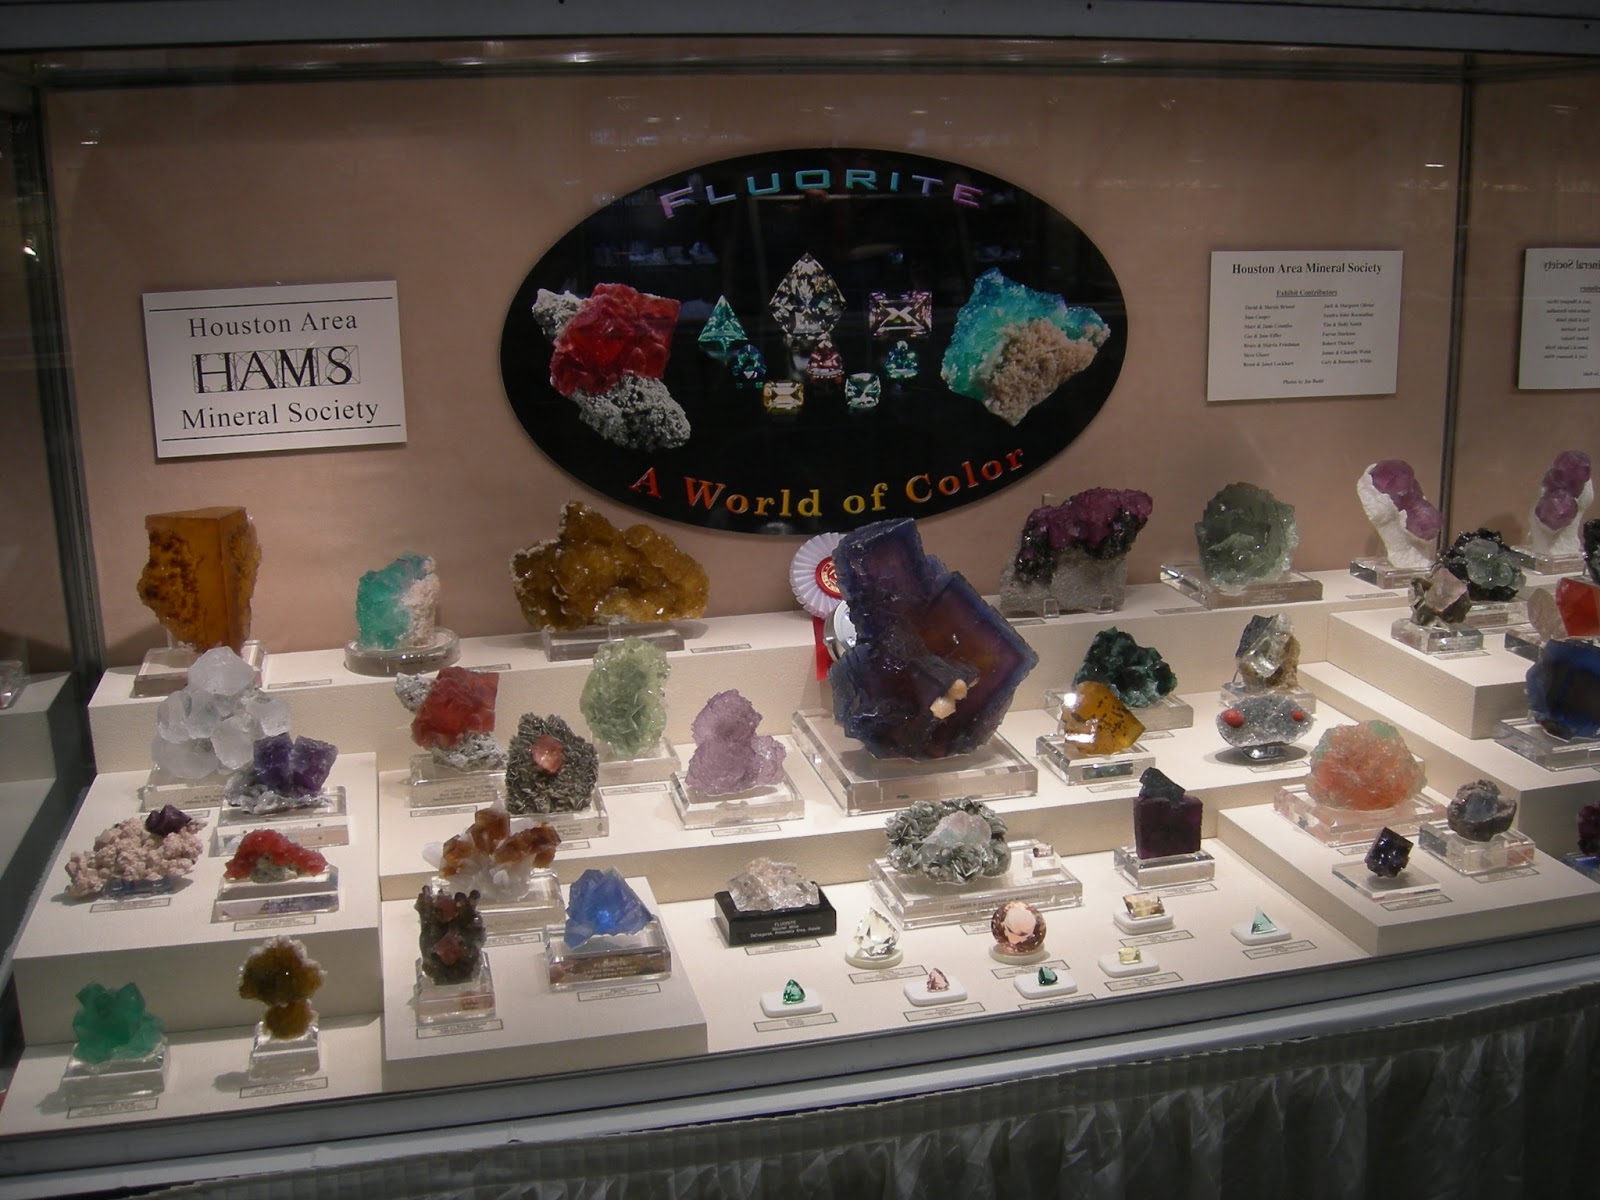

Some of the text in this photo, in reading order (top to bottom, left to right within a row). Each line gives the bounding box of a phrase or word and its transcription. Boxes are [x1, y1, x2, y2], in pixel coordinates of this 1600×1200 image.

[659, 169, 984, 219] FLUORITE
[1232, 262, 1383, 275] Houston Area Mineral Society
[1276, 288, 1338, 297] Exhibit Contributors
[188, 312, 358, 338] Houston Area
[193, 346, 355, 394] HAMS
[181, 399, 379, 430] Mineral Society
[629, 447, 1024, 518] A World of Color
